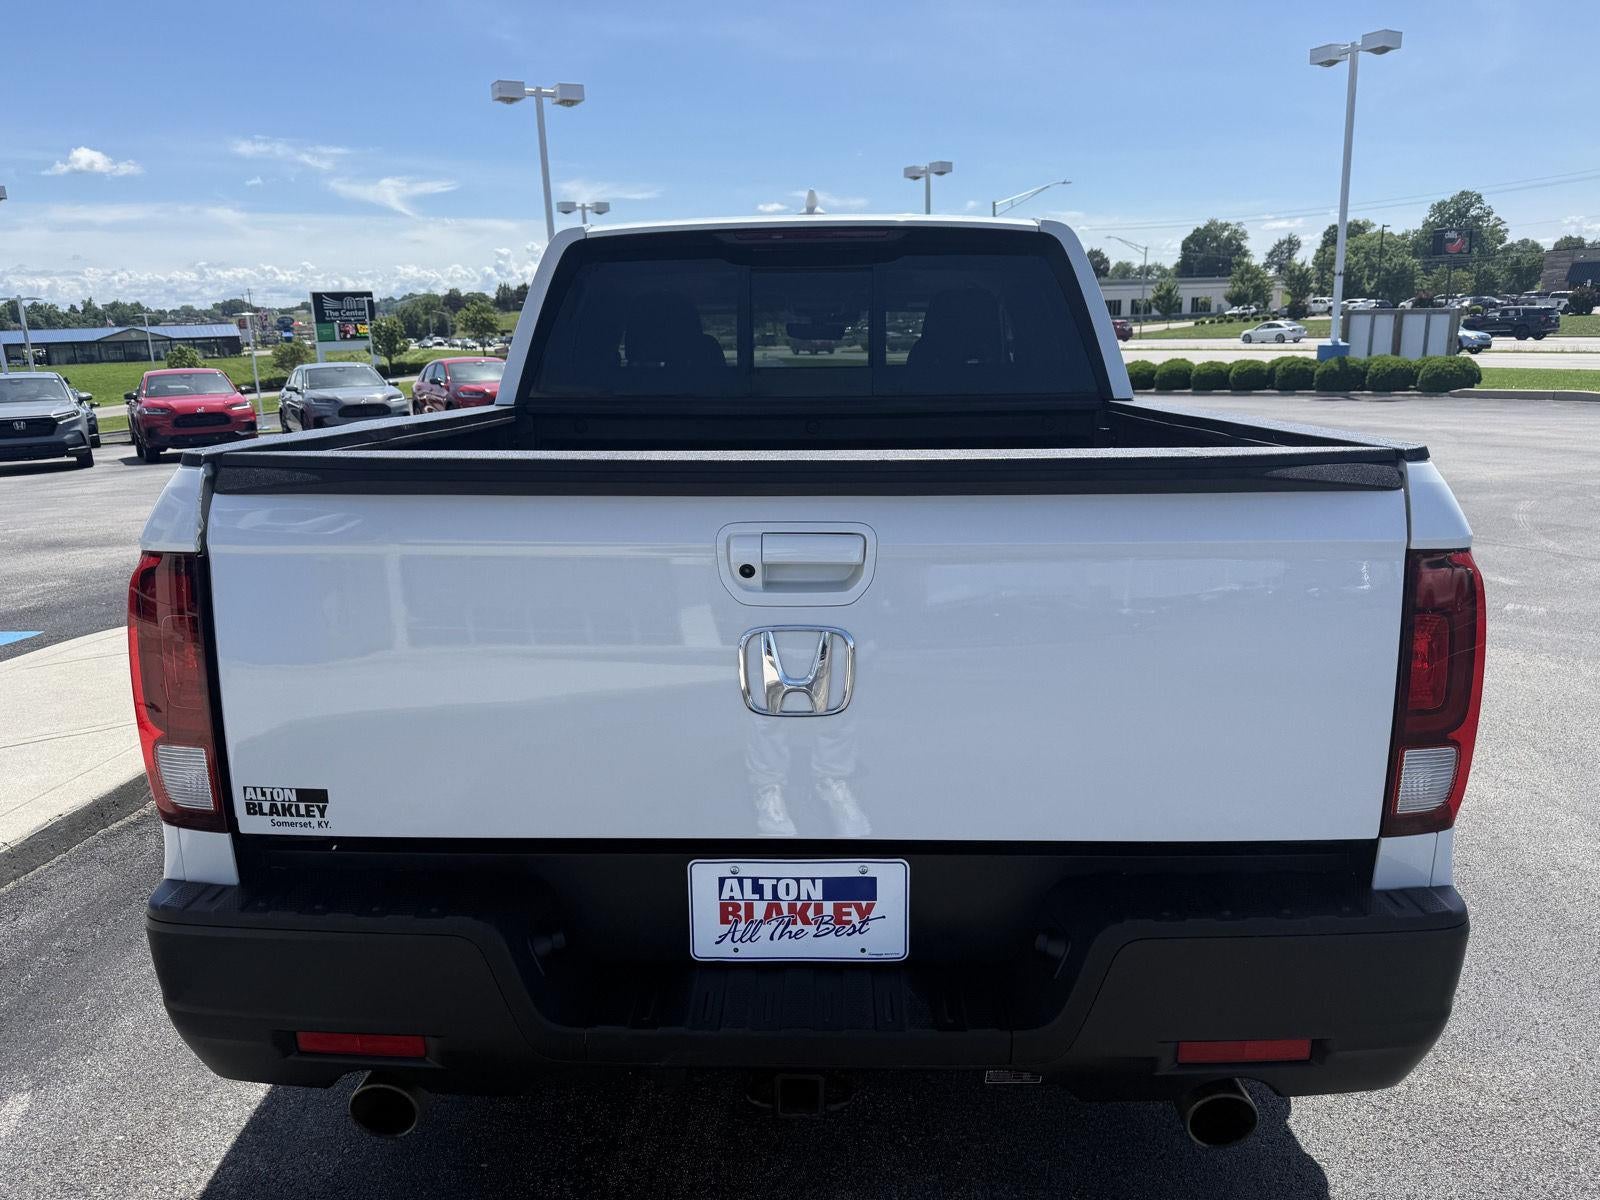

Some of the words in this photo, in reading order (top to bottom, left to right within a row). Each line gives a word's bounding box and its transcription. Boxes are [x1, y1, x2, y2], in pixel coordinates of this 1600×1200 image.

[341, 309, 365, 317] Center
[245, 787, 297, 802] ALTON
[245, 802, 328, 819] BLAKLEY
[270, 819, 315, 830] Somerset,
[317, 820, 332, 829] KY.
[720, 878, 823, 900] ALTON
[719, 902, 876, 926] BLAKLEY
[714, 918, 763, 945] All
[766, 914, 809, 942] The
[813, 914, 886, 938] Best
